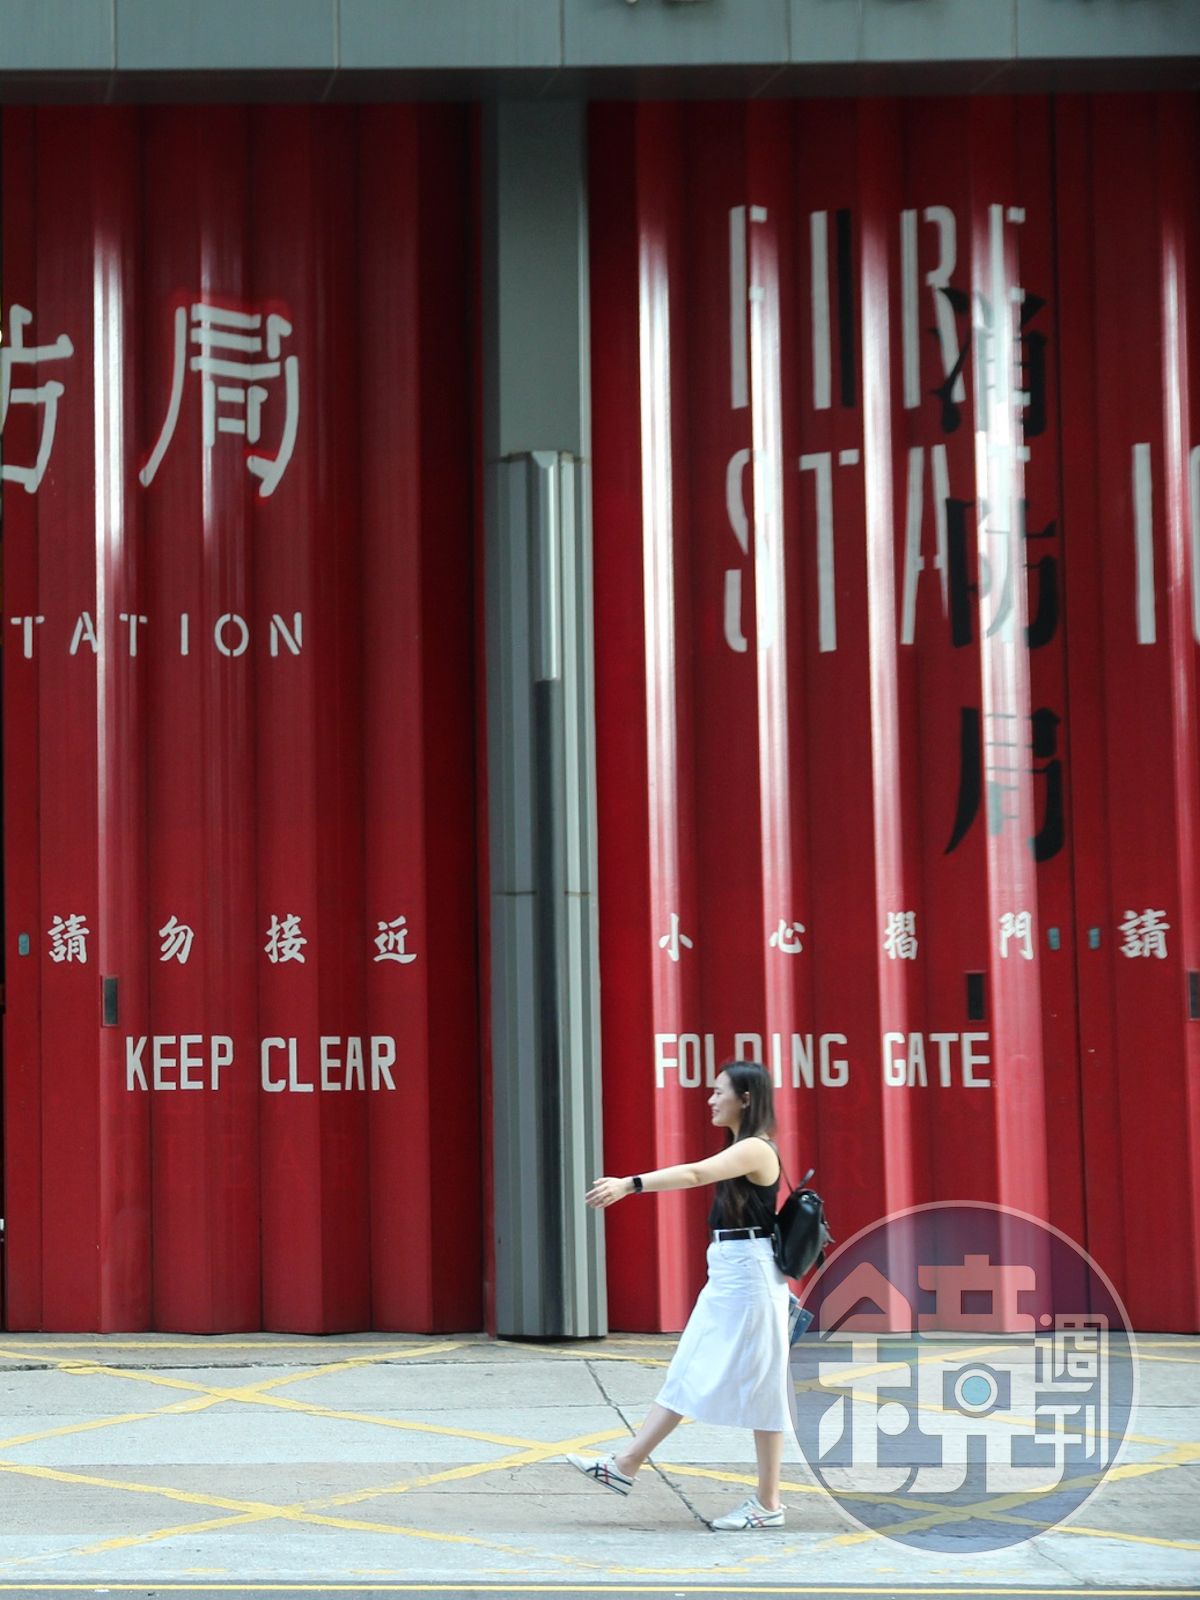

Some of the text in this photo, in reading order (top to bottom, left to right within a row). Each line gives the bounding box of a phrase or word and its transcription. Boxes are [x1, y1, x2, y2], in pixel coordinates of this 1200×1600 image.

[47, 913, 418, 965] 請勿接近
[658, 911, 1034, 962] 小心摺門
[1117, 908, 1171, 960] 請
[126, 1035, 397, 1093] KEEP CLEAR
[882, 1032, 991, 1089] GATE
